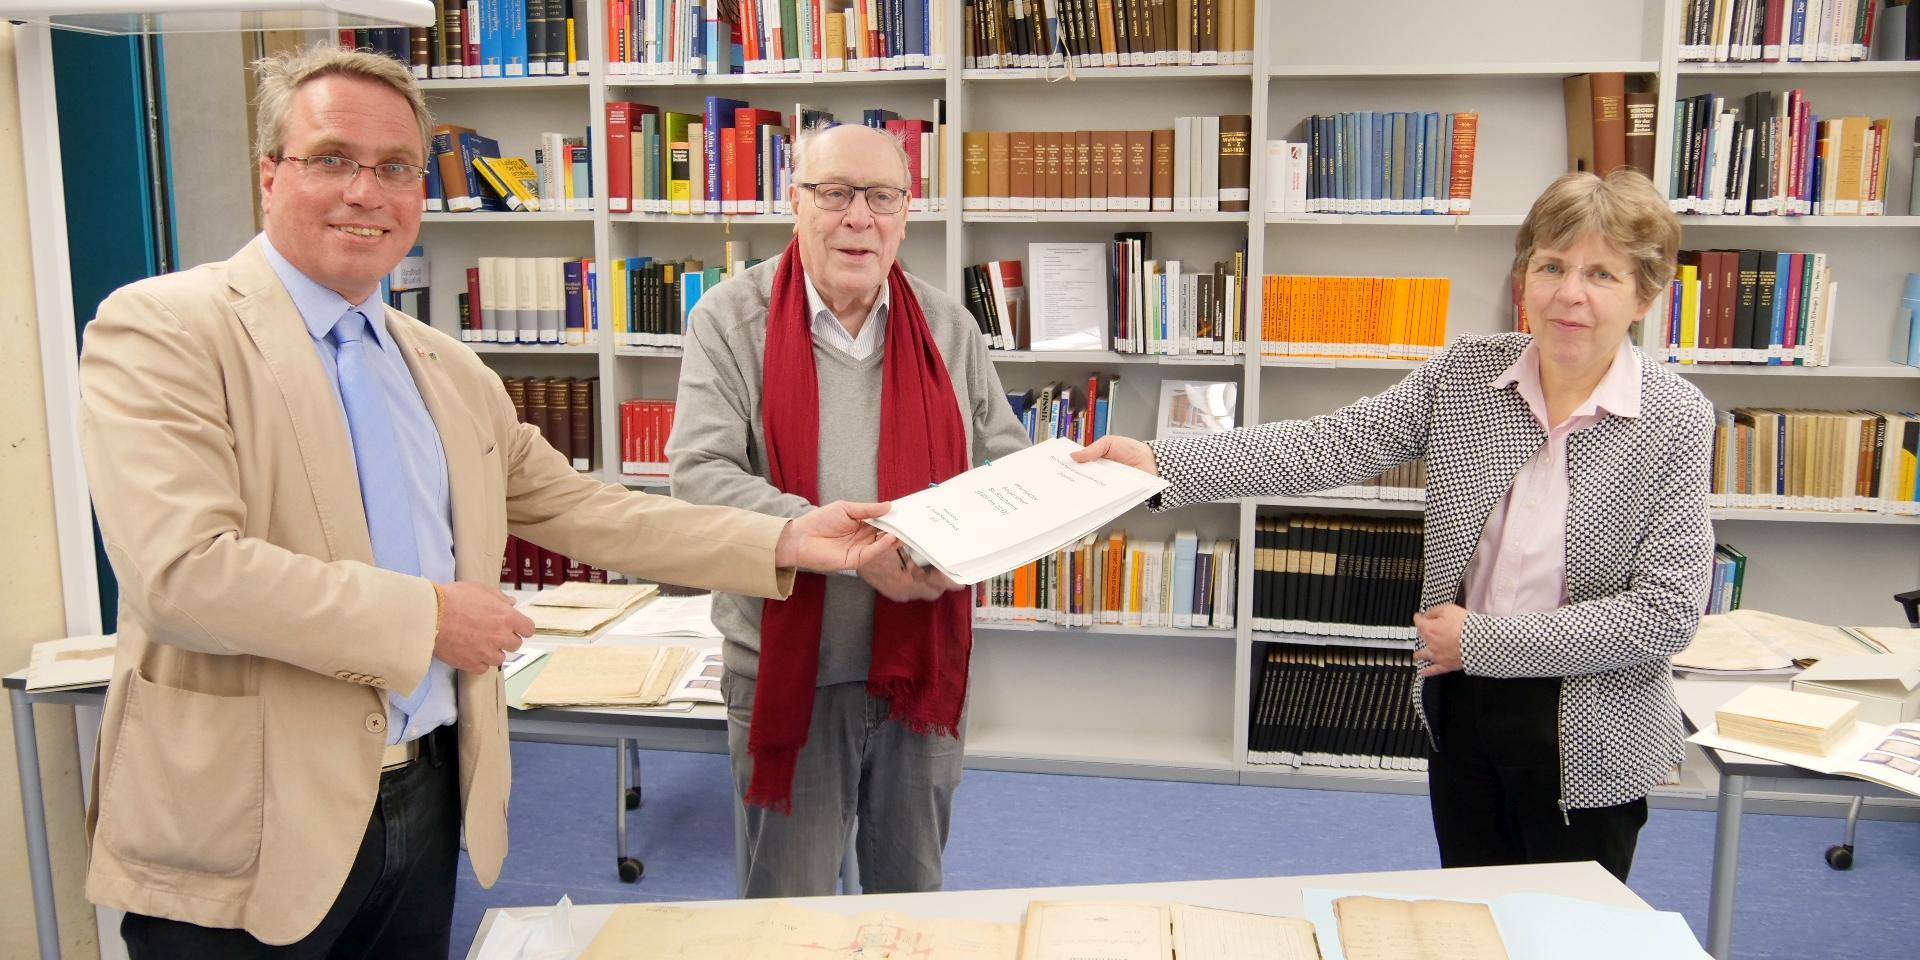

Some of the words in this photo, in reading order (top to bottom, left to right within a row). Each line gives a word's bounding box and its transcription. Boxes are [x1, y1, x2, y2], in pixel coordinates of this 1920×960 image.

[708, 150, 716, 161] der
[708, 163, 717, 192] Heiligen
[1040, 391, 1050, 422] MISSIO
[525, 558, 531, 567] 8
[546, 558, 552, 568] 9
[570, 560, 579, 568] 10
